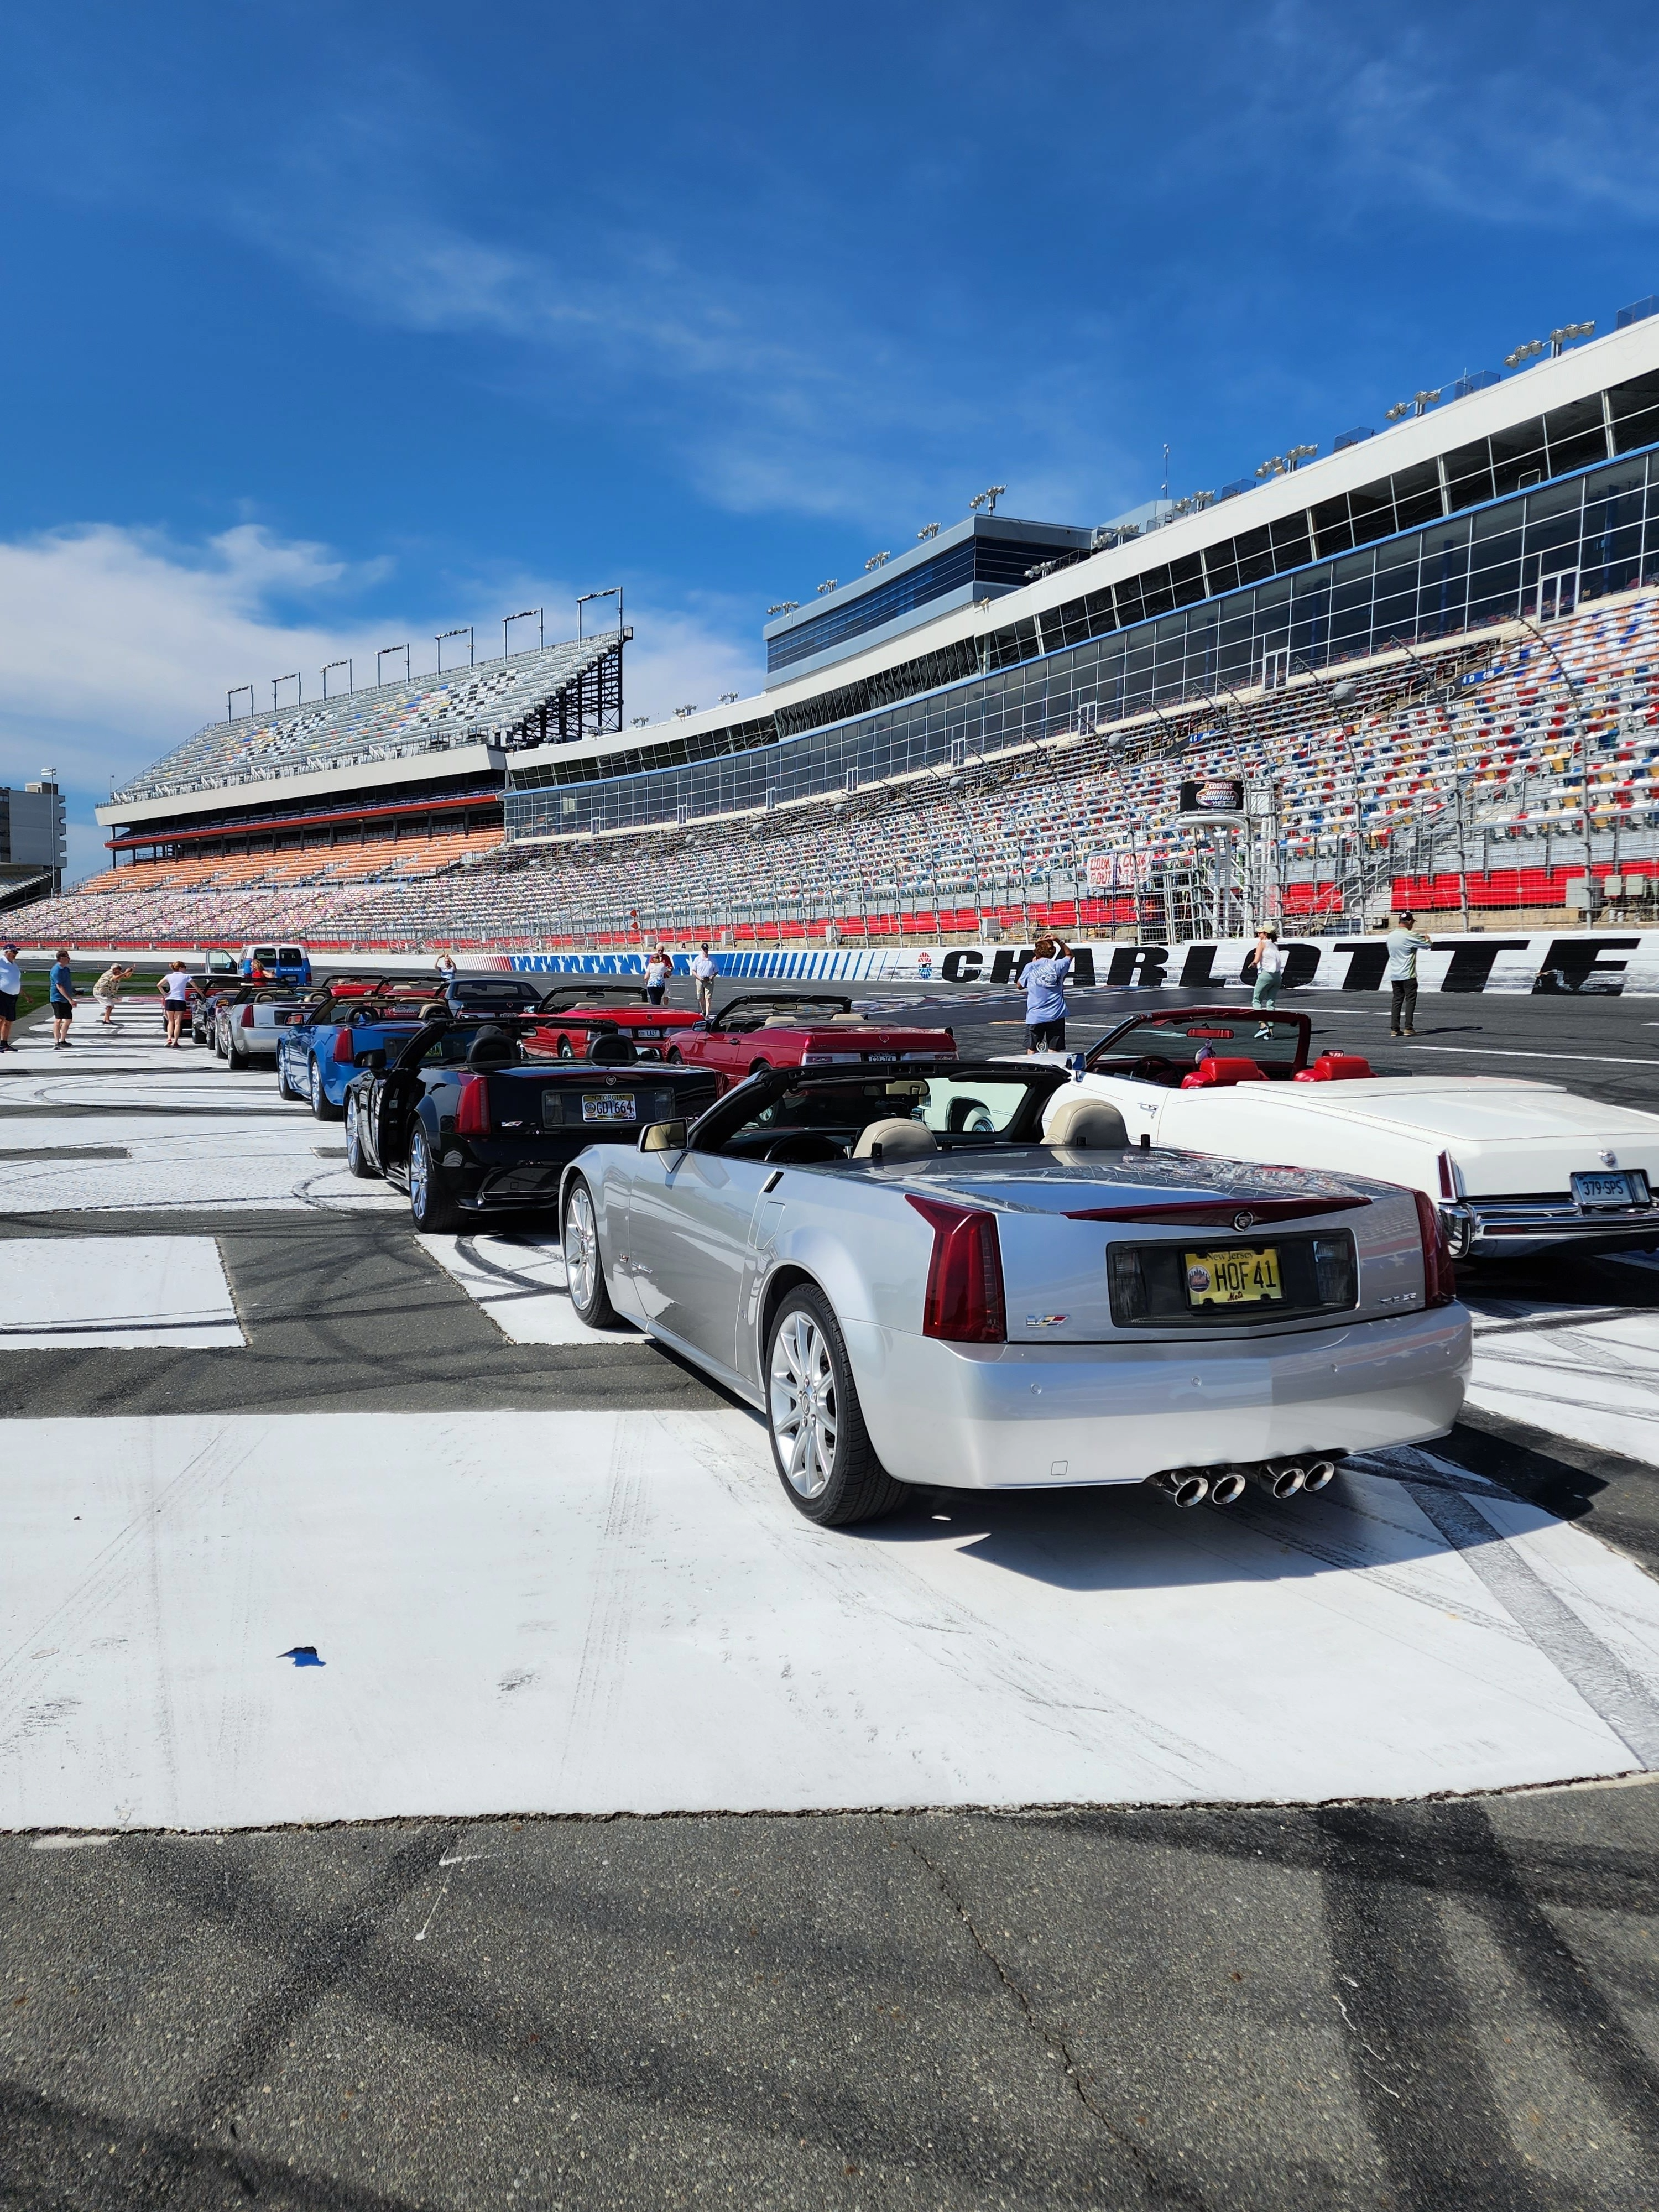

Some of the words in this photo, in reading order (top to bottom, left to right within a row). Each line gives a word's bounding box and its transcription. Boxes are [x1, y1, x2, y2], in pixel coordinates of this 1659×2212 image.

[942, 937, 1642, 997] CHARLOTTE
[1206, 1252, 1225, 1261] New
[1227, 1250, 1254, 1261] Jersey
[1214, 1261, 1250, 1292] HOF
[1253, 1260, 1276, 1289] 41
